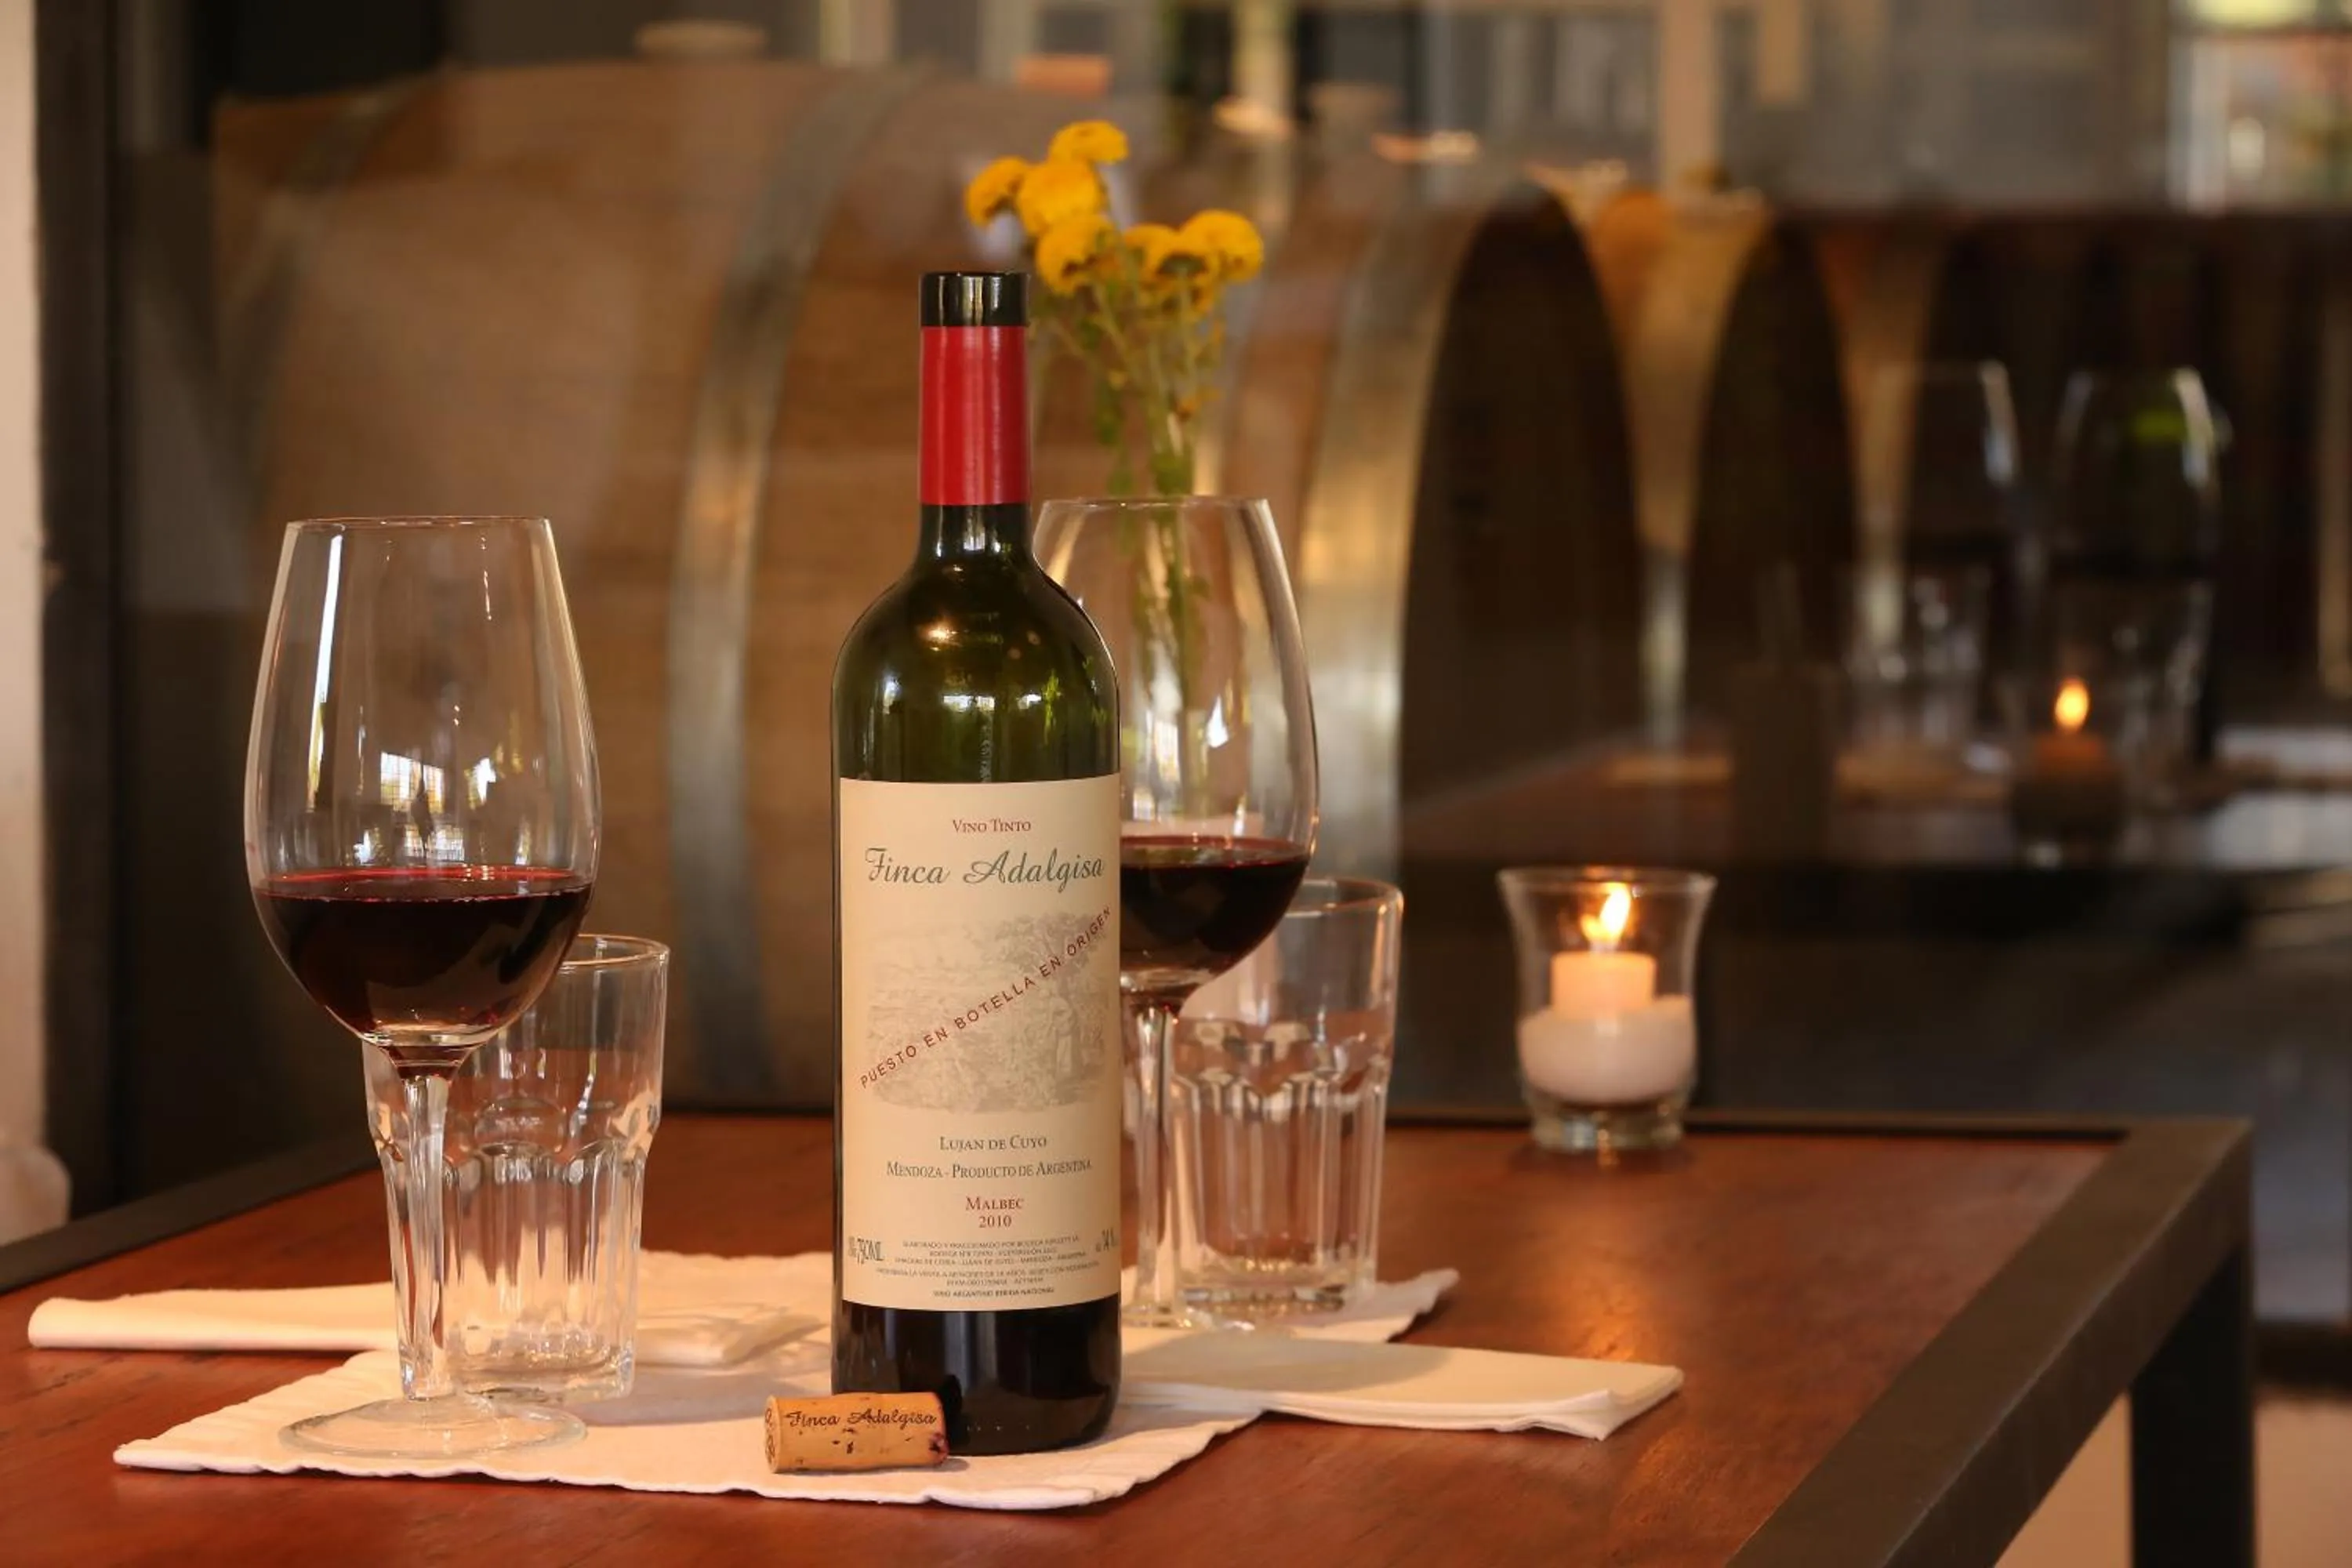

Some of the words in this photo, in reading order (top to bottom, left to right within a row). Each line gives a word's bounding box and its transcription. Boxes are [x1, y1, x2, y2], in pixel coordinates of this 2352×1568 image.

[953, 819, 987, 833] VINO
[990, 818, 1032, 833] TINTO
[865, 847, 951, 884] Finca
[963, 848, 1104, 893] Adalgisa
[860, 1045, 917, 1089] PUESTO
[924, 1028, 949, 1048] EN
[954, 977, 1036, 1030] BOTELLA
[1039, 956, 1062, 978] EN
[1066, 906, 1112, 956] ORIGEN
[940, 1136, 984, 1152] LUJAN
[989, 1138, 1007, 1150] DE
[1009, 1134, 1047, 1149] CUYO
[886, 1160, 942, 1178] MENDOZA
[952, 1163, 1016, 1178] PRODUCTO
[1018, 1165, 1034, 1177] DE
[1036, 1159, 1092, 1176] ARGENTINA
[965, 1196, 1025, 1211] MALBEC
[978, 1215, 1013, 1229] 2010
[786, 1410, 840, 1428] Finca
[847, 1408, 937, 1429] Adalgisa
